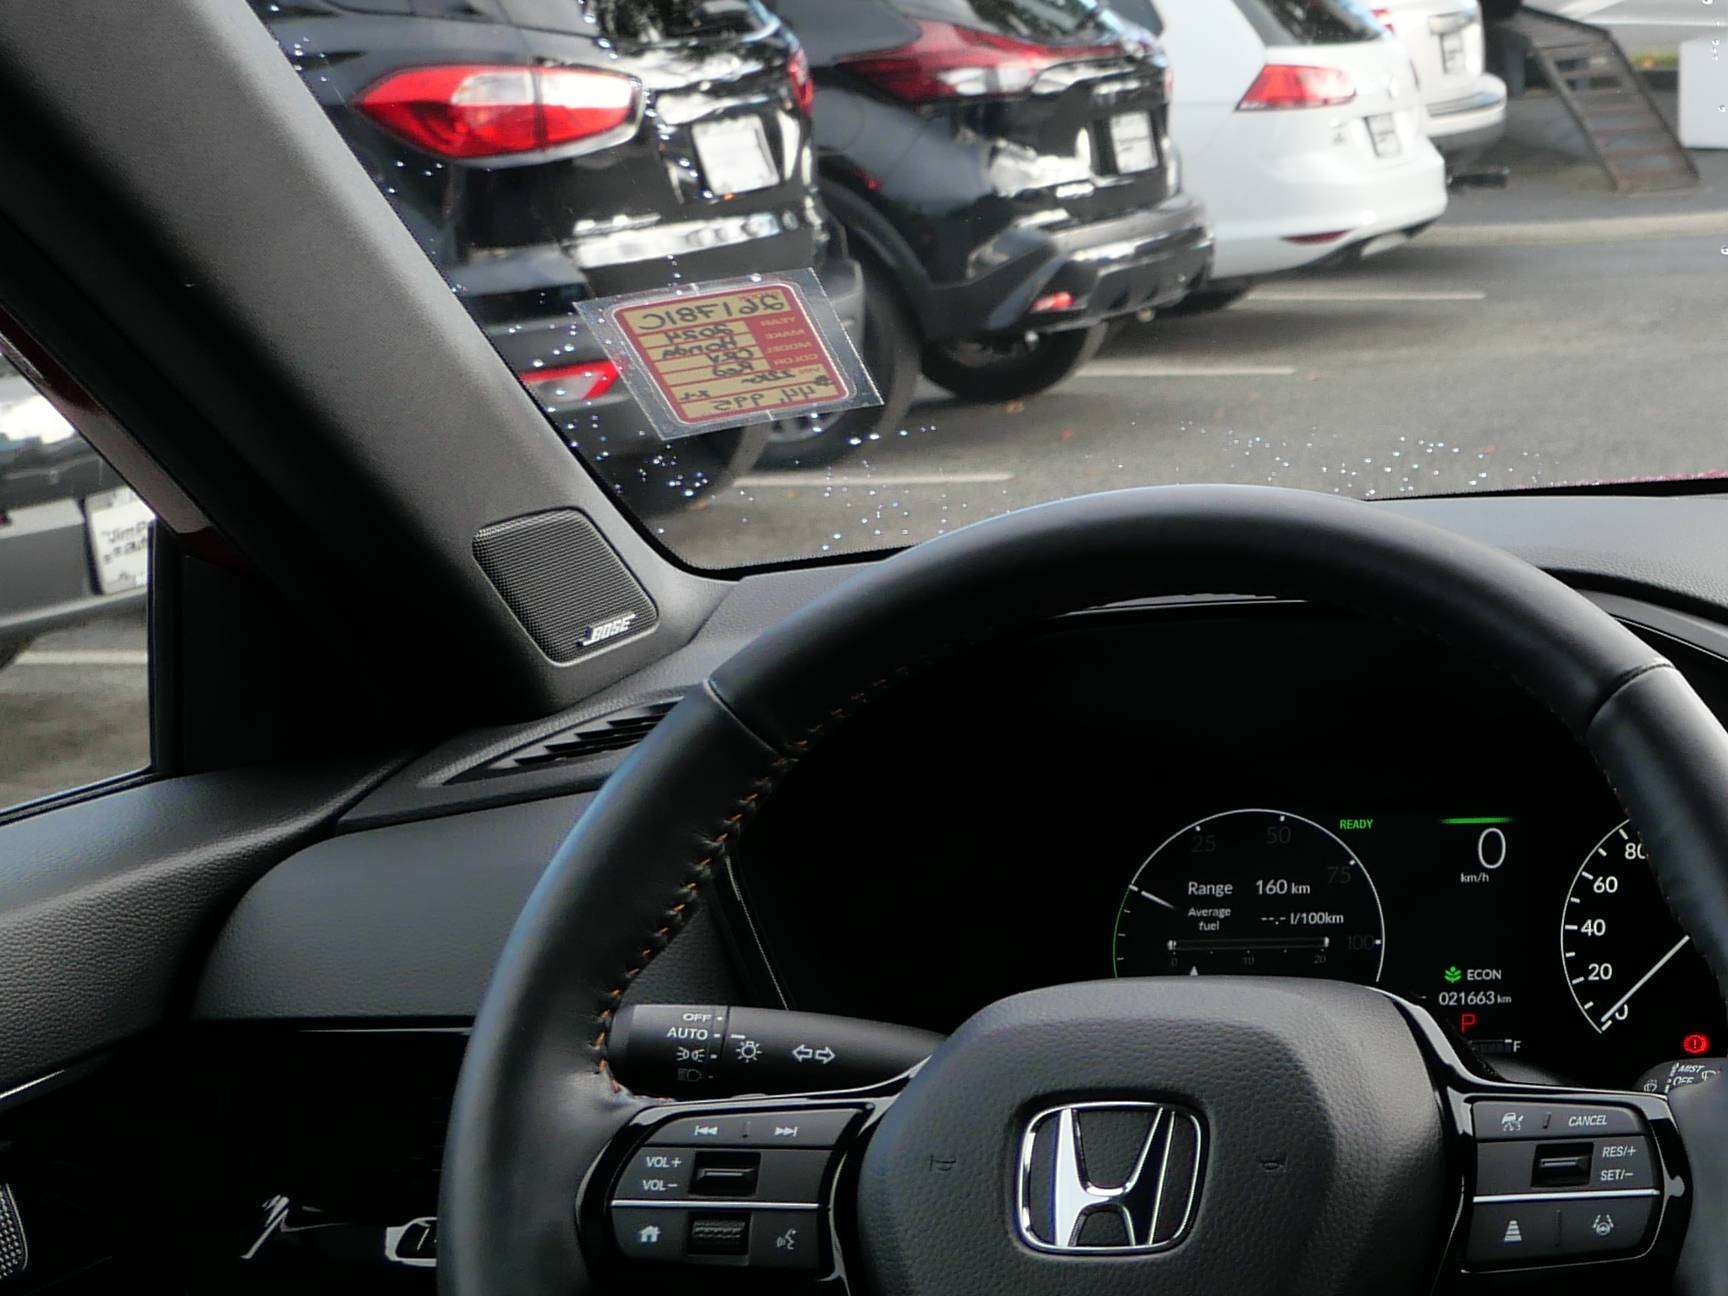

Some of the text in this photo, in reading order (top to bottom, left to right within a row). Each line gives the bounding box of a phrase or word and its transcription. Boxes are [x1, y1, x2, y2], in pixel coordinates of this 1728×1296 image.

[1339, 818, 1374, 830] READY
[1477, 827, 1507, 869] 0
[1459, 871, 1490, 884] km/h
[1187, 879, 1311, 897] Range 160 km
[1592, 875, 1619, 894] 60
[1187, 907, 1232, 920] Average
[1198, 920, 1220, 931] fuel
[1580, 918, 1607, 937] 40
[1466, 968, 1502, 981] ECON
[1587, 963, 1613, 981] 20
[1438, 990, 1512, 1006] 021663 km
[666, 1027, 709, 1041] AUTO
[1567, 1114, 1608, 1127] CANCEL
[1601, 1146, 1637, 1158] RES/+
